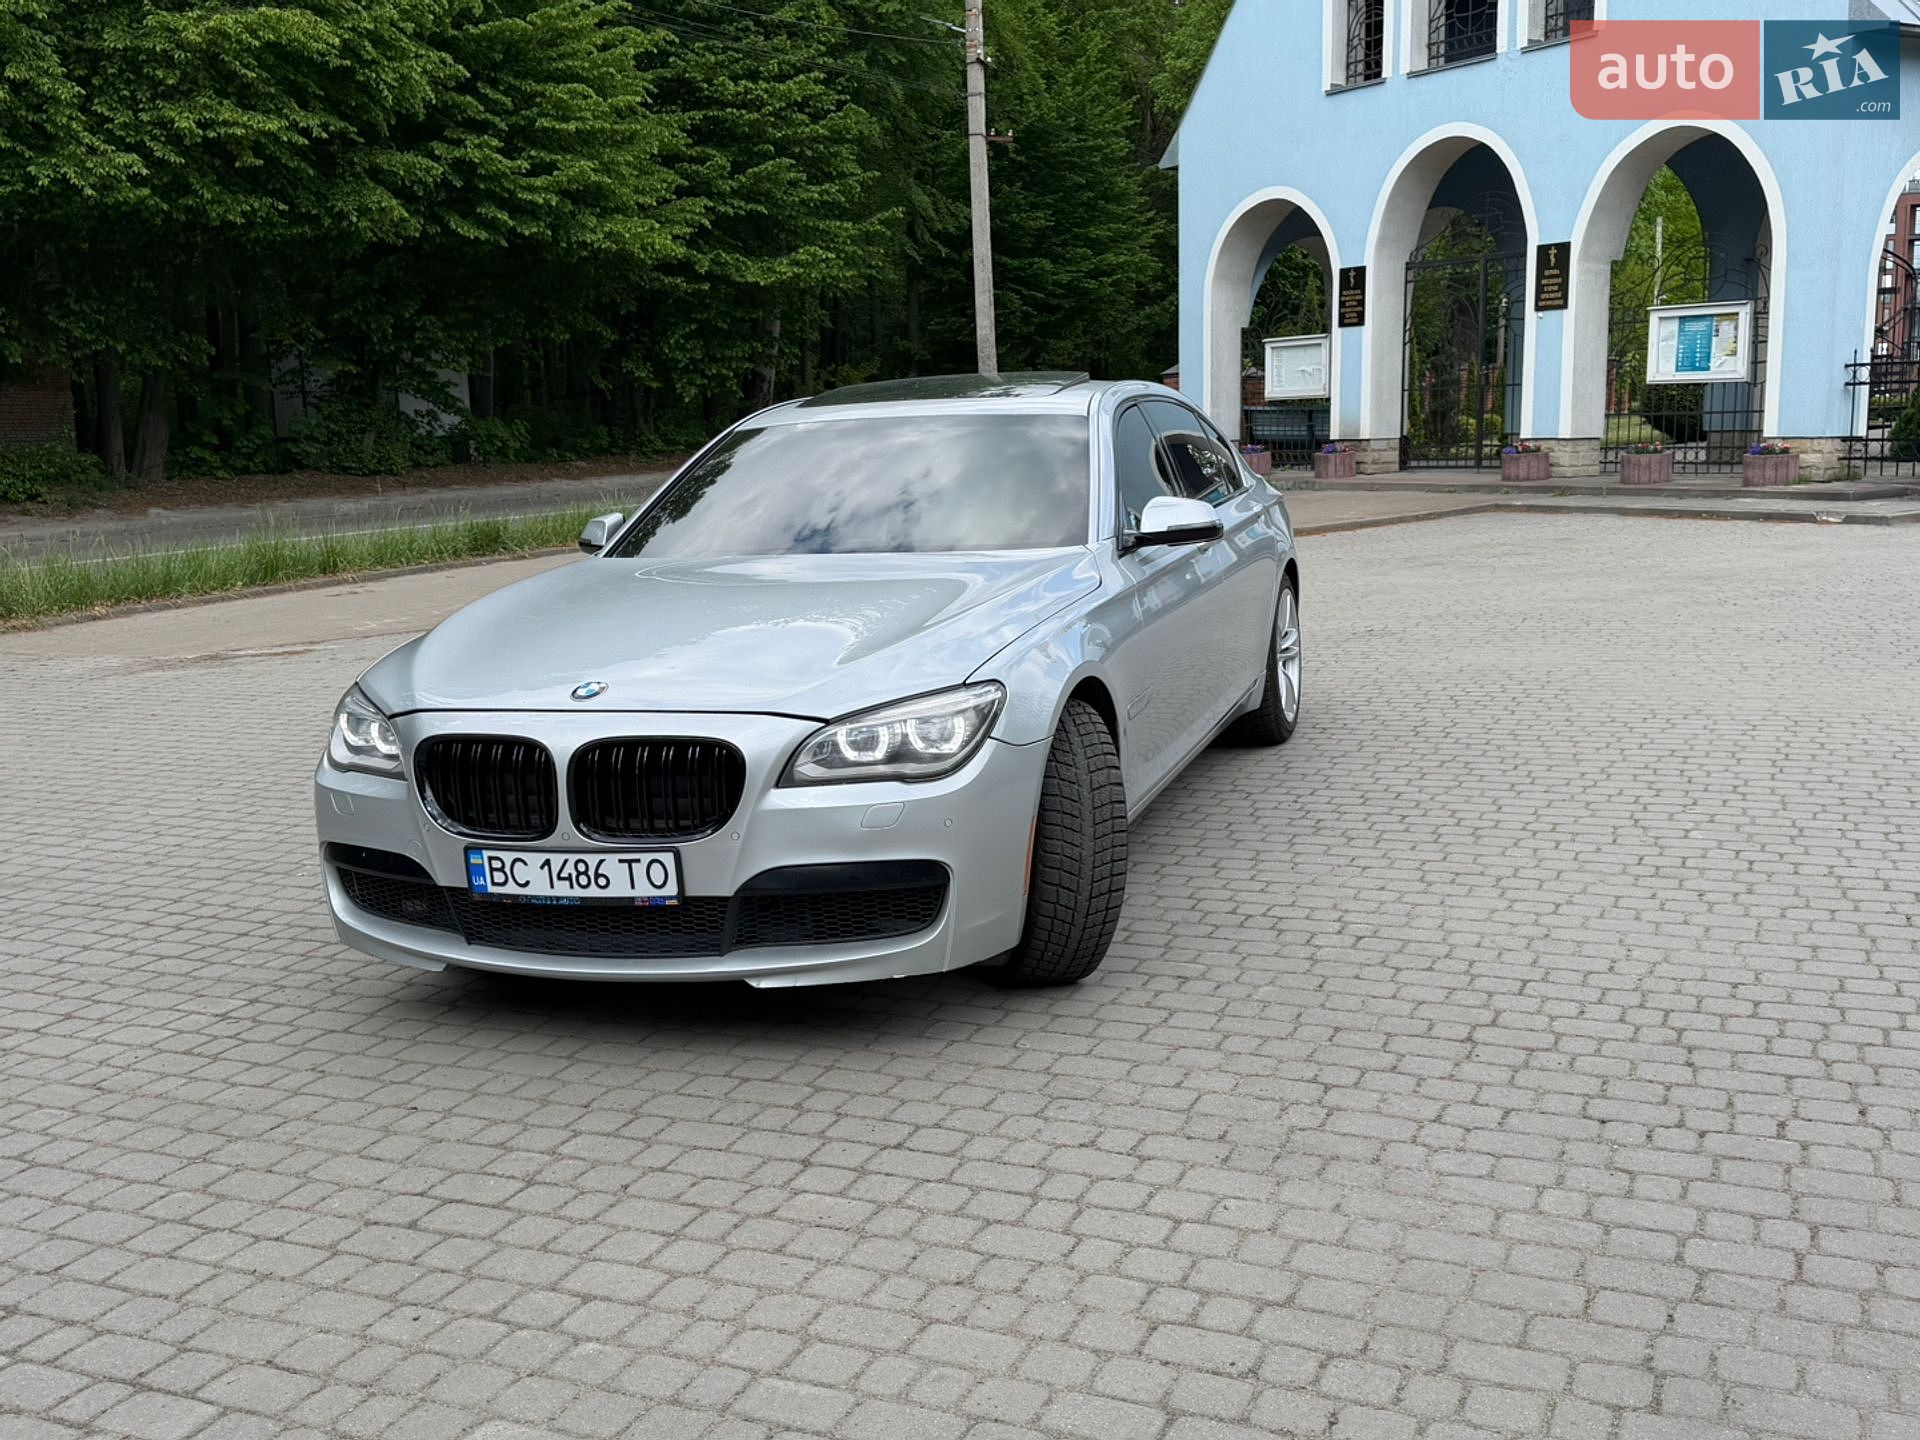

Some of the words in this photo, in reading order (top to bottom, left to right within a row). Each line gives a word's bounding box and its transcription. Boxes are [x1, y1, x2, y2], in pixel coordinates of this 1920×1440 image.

[471, 875, 486, 886] UA
[487, 855, 531, 888] BC
[539, 857, 611, 890] 1486
[618, 858, 669, 890] TO
